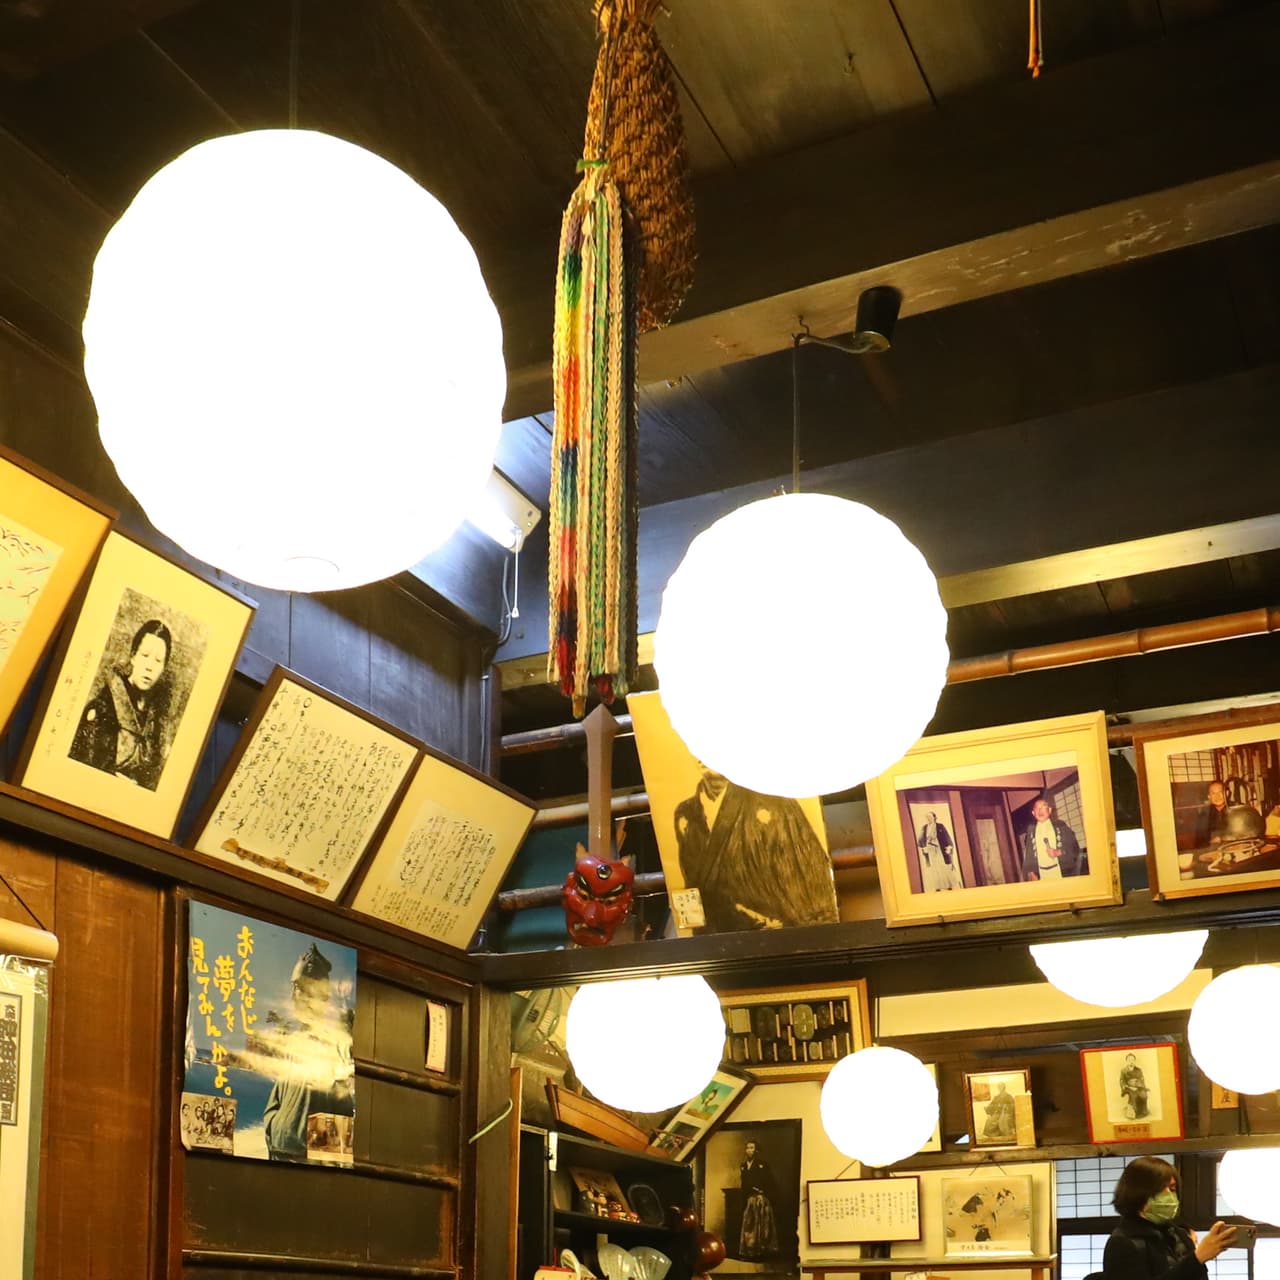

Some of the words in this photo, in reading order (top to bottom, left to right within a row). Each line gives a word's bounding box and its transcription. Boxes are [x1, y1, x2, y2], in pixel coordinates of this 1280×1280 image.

[212, 954, 238, 1033] 夢を
[234, 925, 258, 1036] おんなじ
